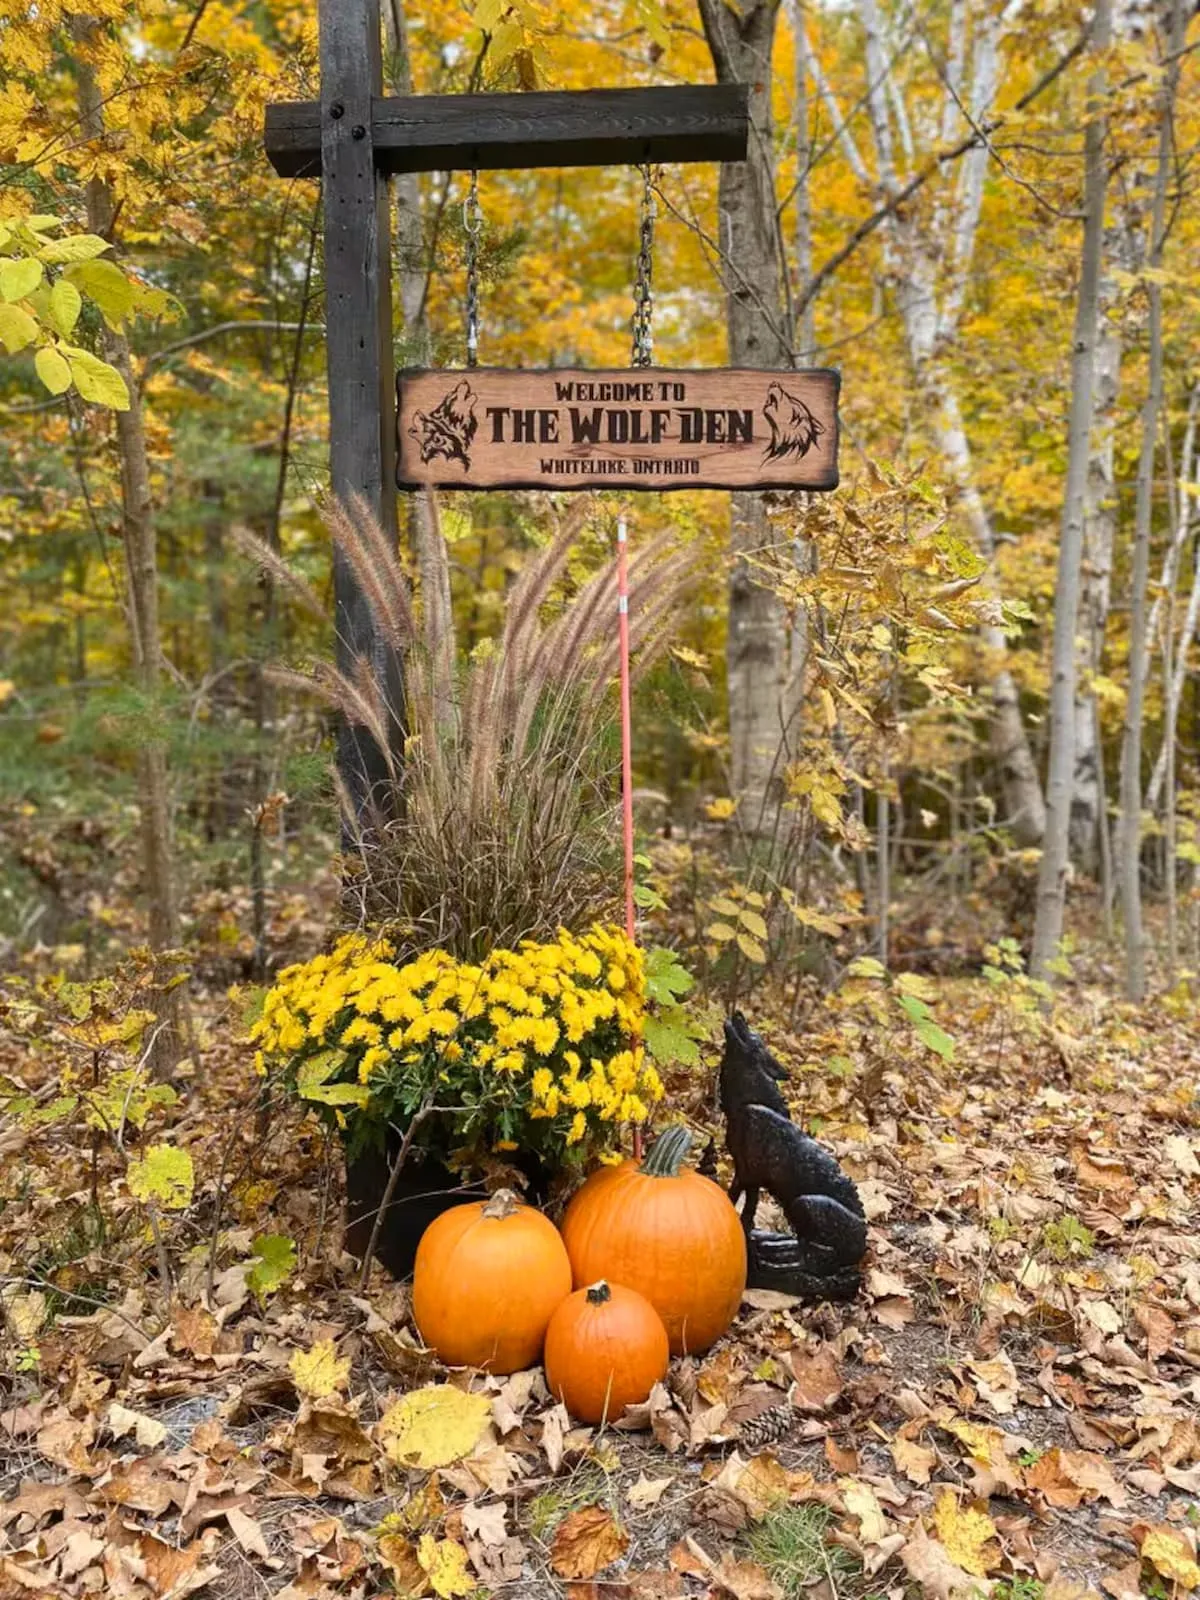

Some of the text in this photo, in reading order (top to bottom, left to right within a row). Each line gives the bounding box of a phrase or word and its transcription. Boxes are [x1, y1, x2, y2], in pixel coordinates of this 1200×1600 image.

[554, 382, 686, 402] WELCOME TO
[486, 407, 755, 444] THE WOLF DEN
[632, 458, 700, 474] ONTARIO
